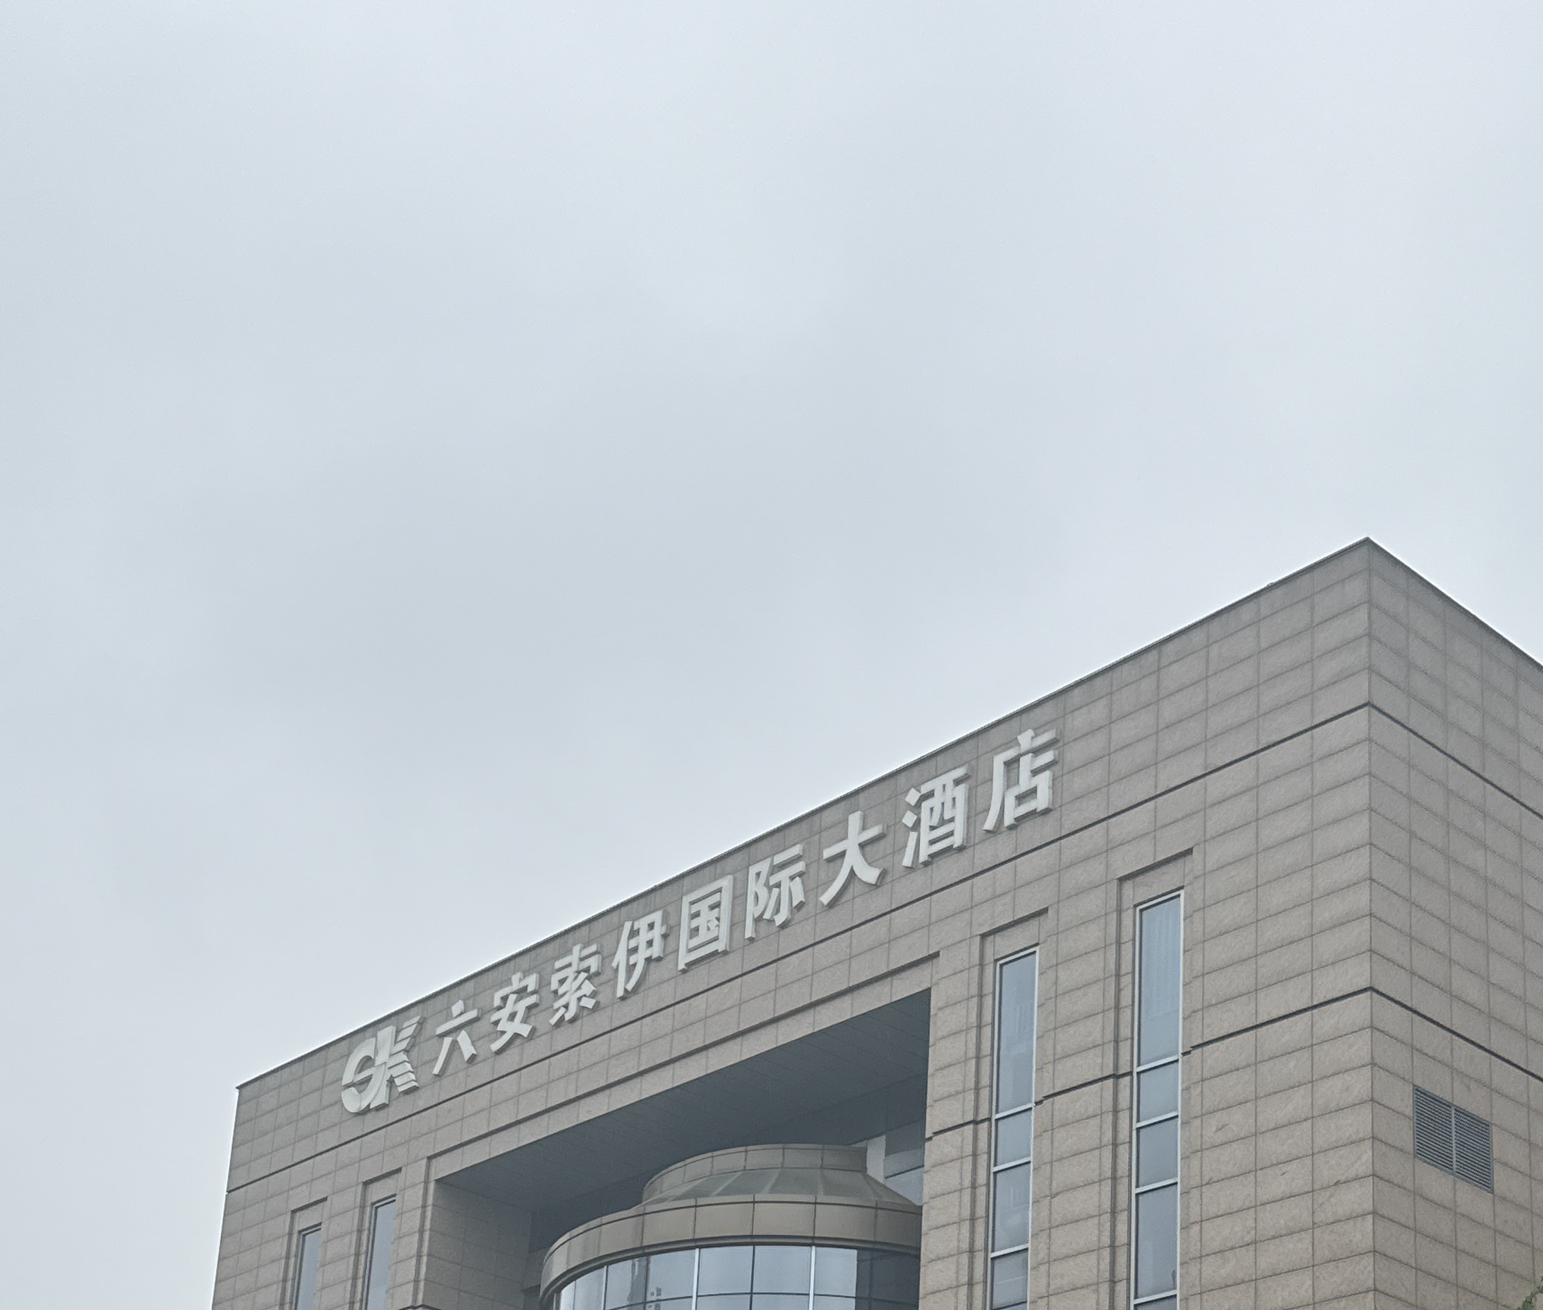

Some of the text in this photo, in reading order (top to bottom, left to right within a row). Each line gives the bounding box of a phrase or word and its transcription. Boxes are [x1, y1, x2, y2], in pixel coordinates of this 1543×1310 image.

[432, 728, 1058, 1076] 六安索伊国际大酒店
